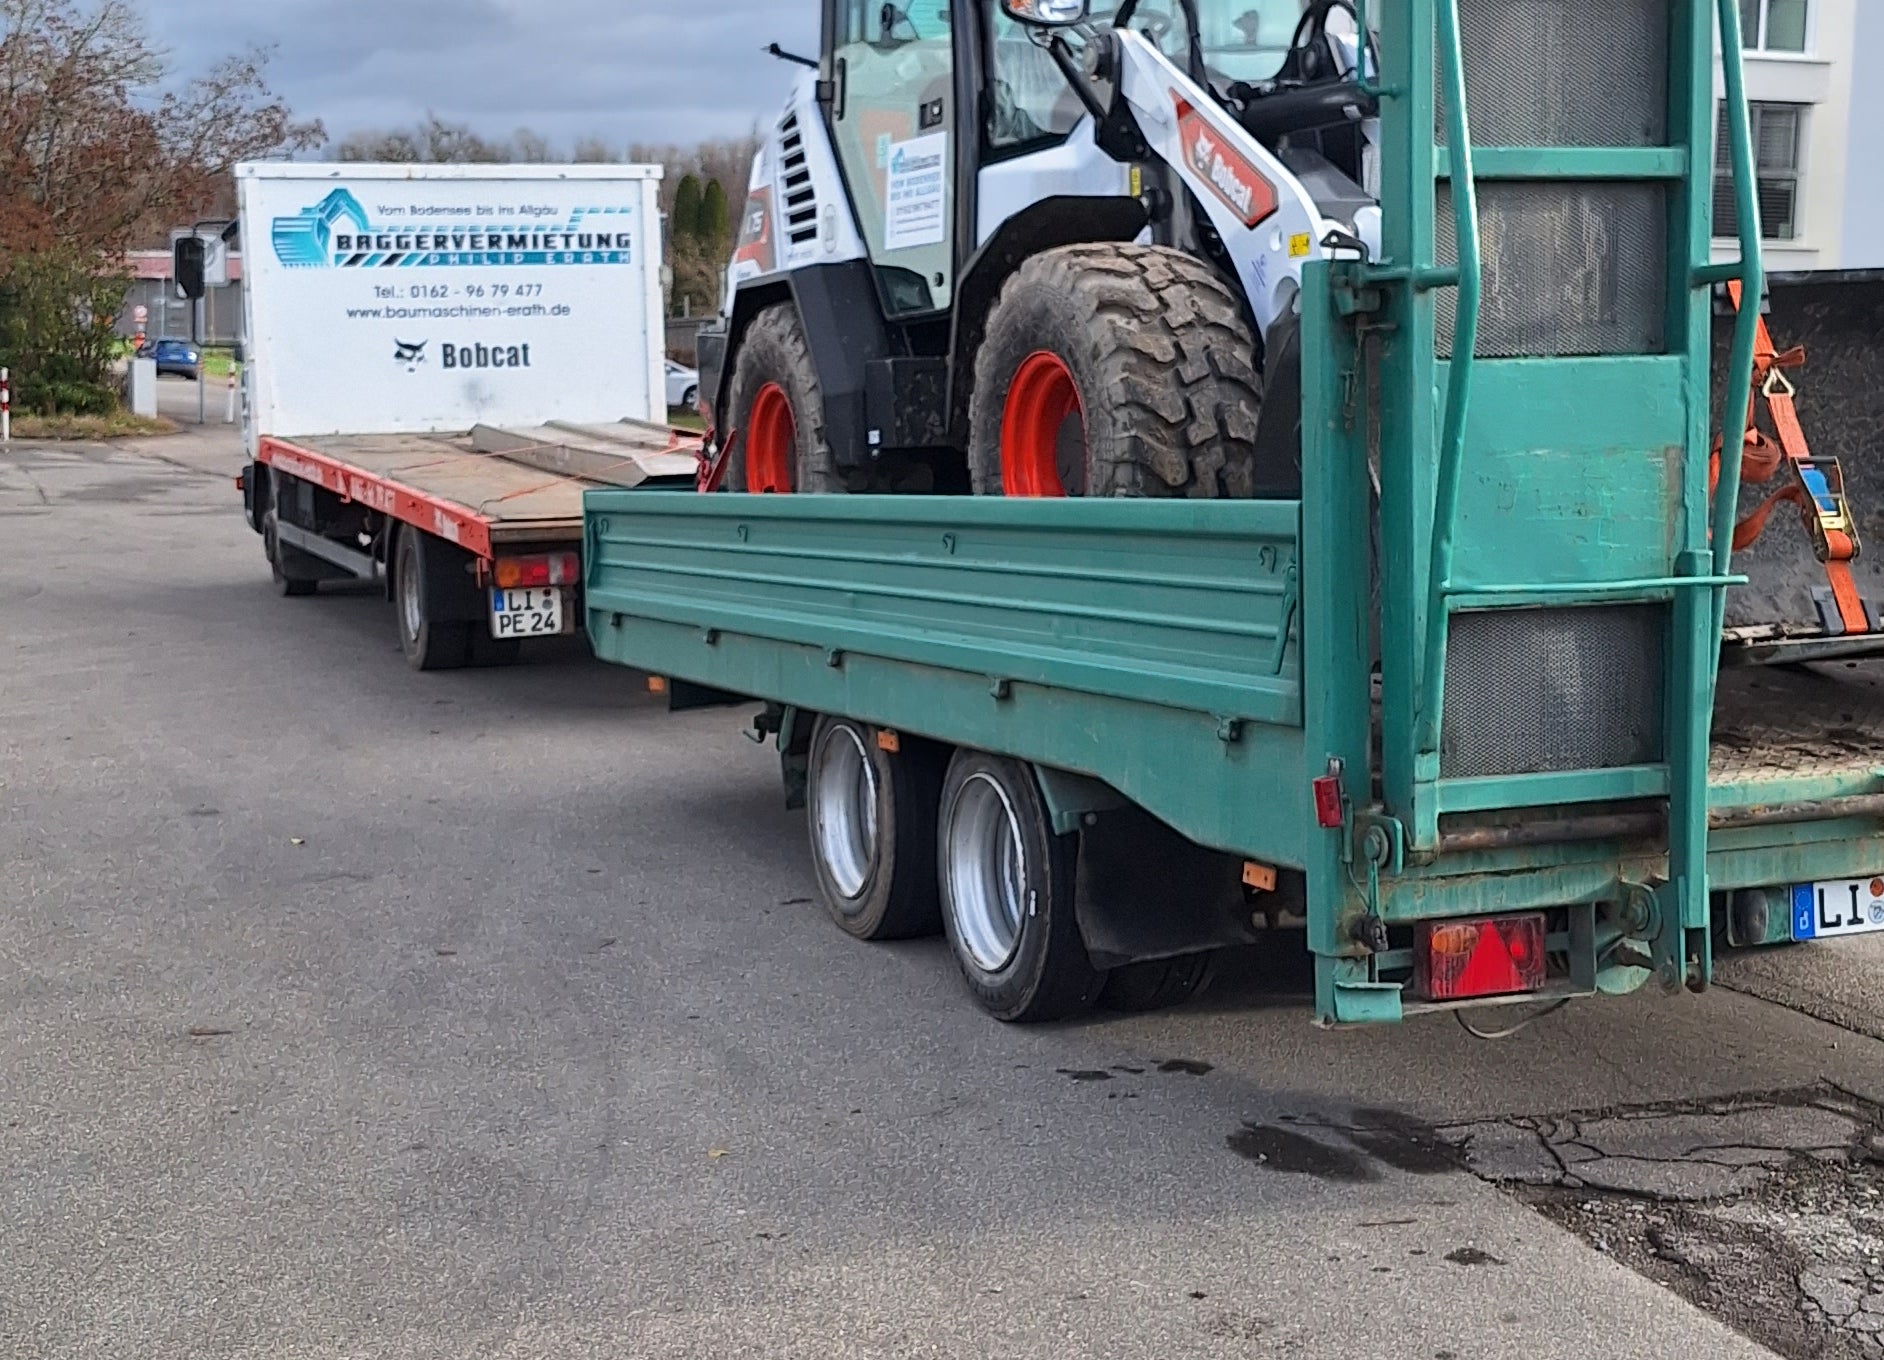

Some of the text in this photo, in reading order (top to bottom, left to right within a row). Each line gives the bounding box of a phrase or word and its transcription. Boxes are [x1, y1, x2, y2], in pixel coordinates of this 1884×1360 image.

[377, 204, 559, 217] Vom Bodensee bis ins Allgäu
[336, 233, 632, 251] BAGGERVERMIETUNG
[429, 251, 631, 265] PHILIP ERATH
[374, 285, 404, 299] Tel.:
[410, 285, 449, 299] 0162
[466, 284, 485, 298] 96
[491, 284, 509, 297] 79
[514, 283, 543, 297] 477
[347, 303, 571, 319] www.baumaschinen-erath.de
[441, 342, 531, 369] Bobcat
[508, 590, 535, 611] LI
[499, 611, 555, 634] PE 24
[1818, 884, 1864, 929] LI
